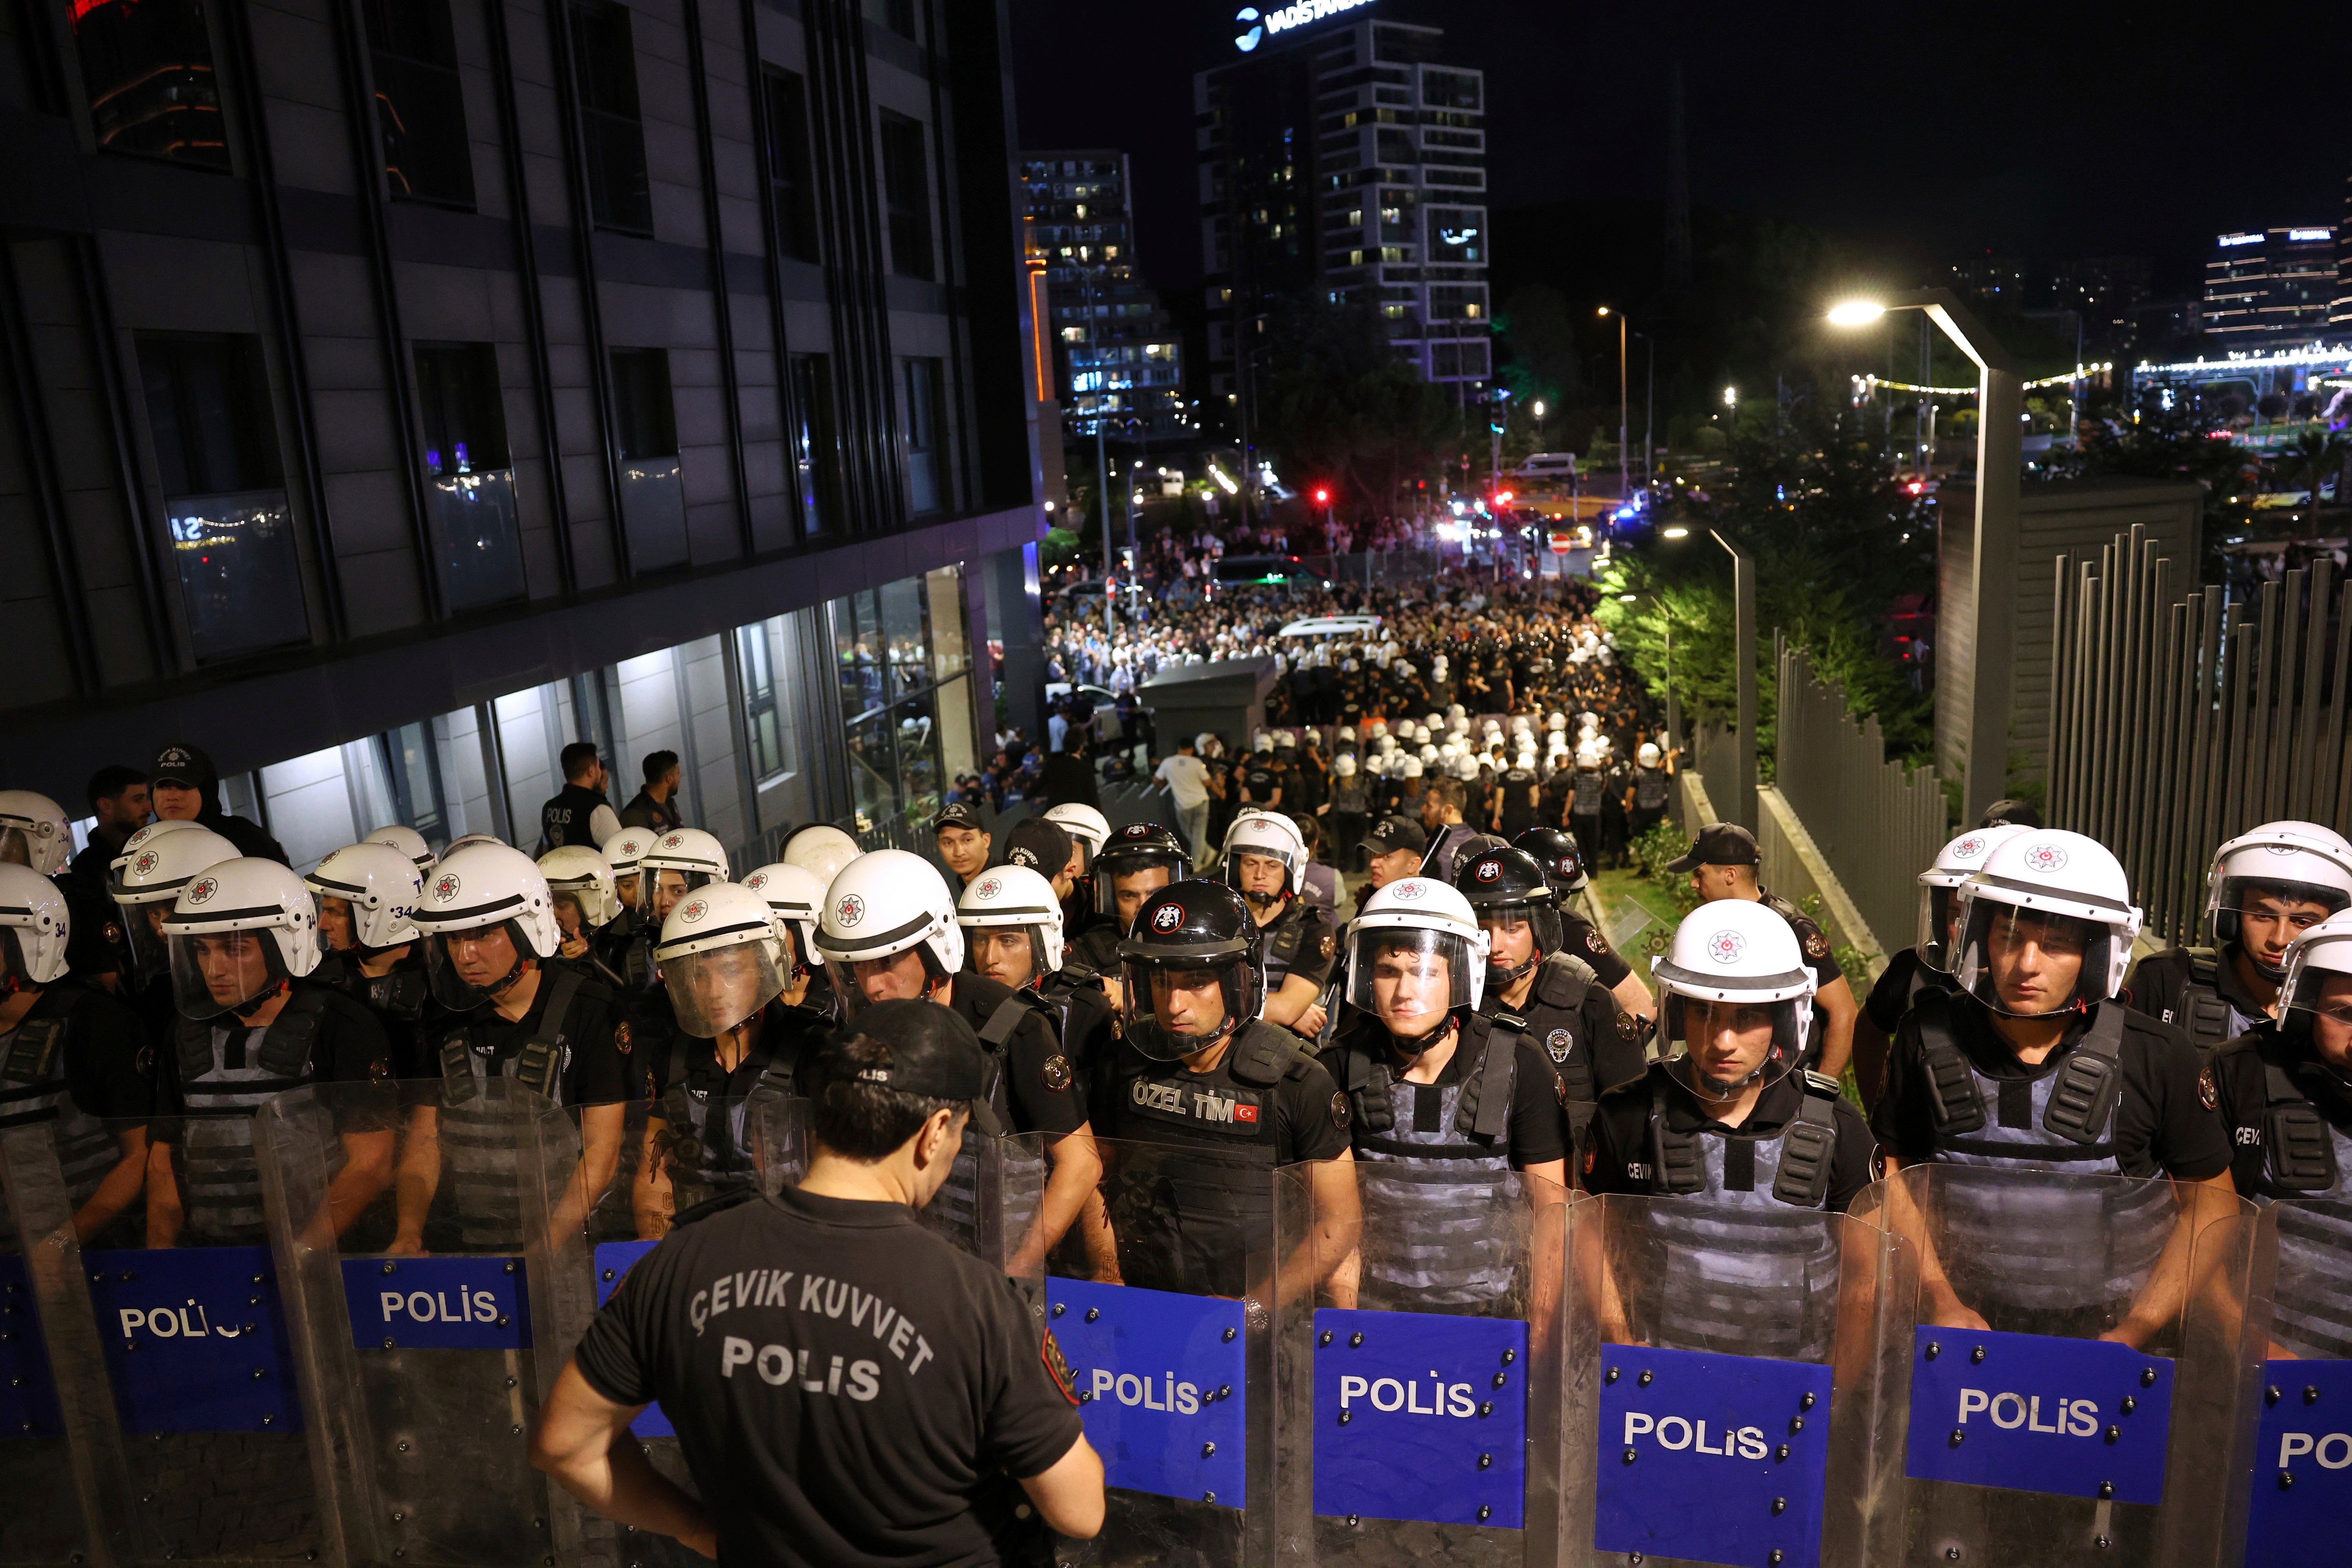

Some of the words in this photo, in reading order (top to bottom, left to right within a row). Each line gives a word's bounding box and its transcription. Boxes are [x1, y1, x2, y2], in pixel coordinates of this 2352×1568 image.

[1020, 847, 1039, 865] KUVVET
[55, 922, 66, 938] 34
[307, 912, 316, 930] 34
[394, 906, 412, 918] 34
[1133, 1075, 1186, 1115] ÖZEL
[1194, 1089, 1235, 1123] TİM
[381, 1285, 497, 1322] POLİS
[690, 1270, 794, 1337] ÇEVİK
[799, 1274, 934, 1375] KUVVET
[721, 1336, 881, 1401] POLİS
[1093, 1369, 1199, 1415] POLİS
[1341, 1370, 1476, 1417] POLİS
[1959, 1388, 2098, 1437] POLİS
